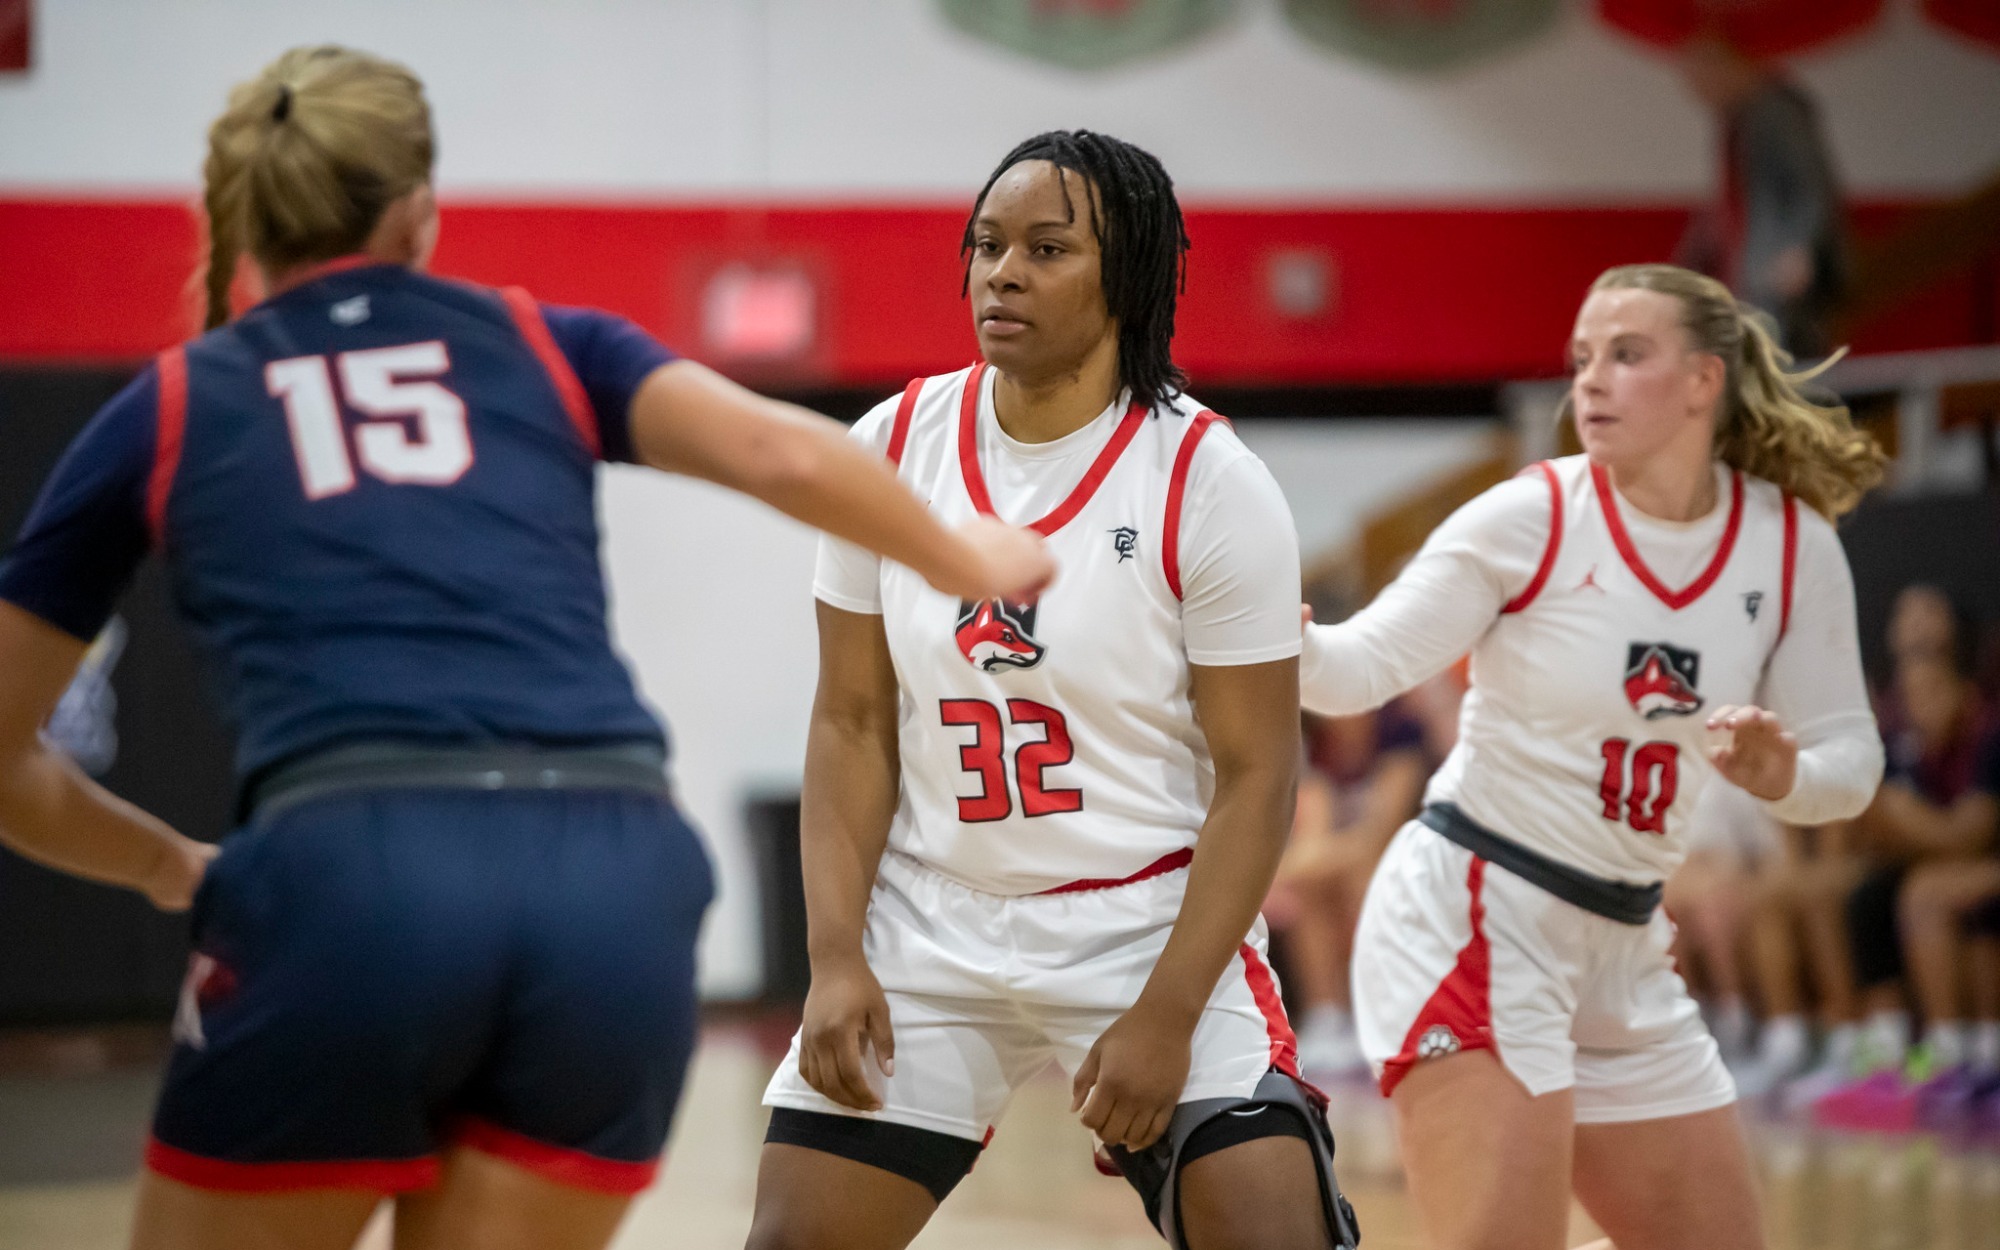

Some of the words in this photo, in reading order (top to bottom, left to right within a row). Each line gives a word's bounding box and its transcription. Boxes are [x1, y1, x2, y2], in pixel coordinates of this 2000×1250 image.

[264, 340, 474, 500] 15
[939, 698, 1083, 823] 32
[1600, 737, 1680, 835] 10
